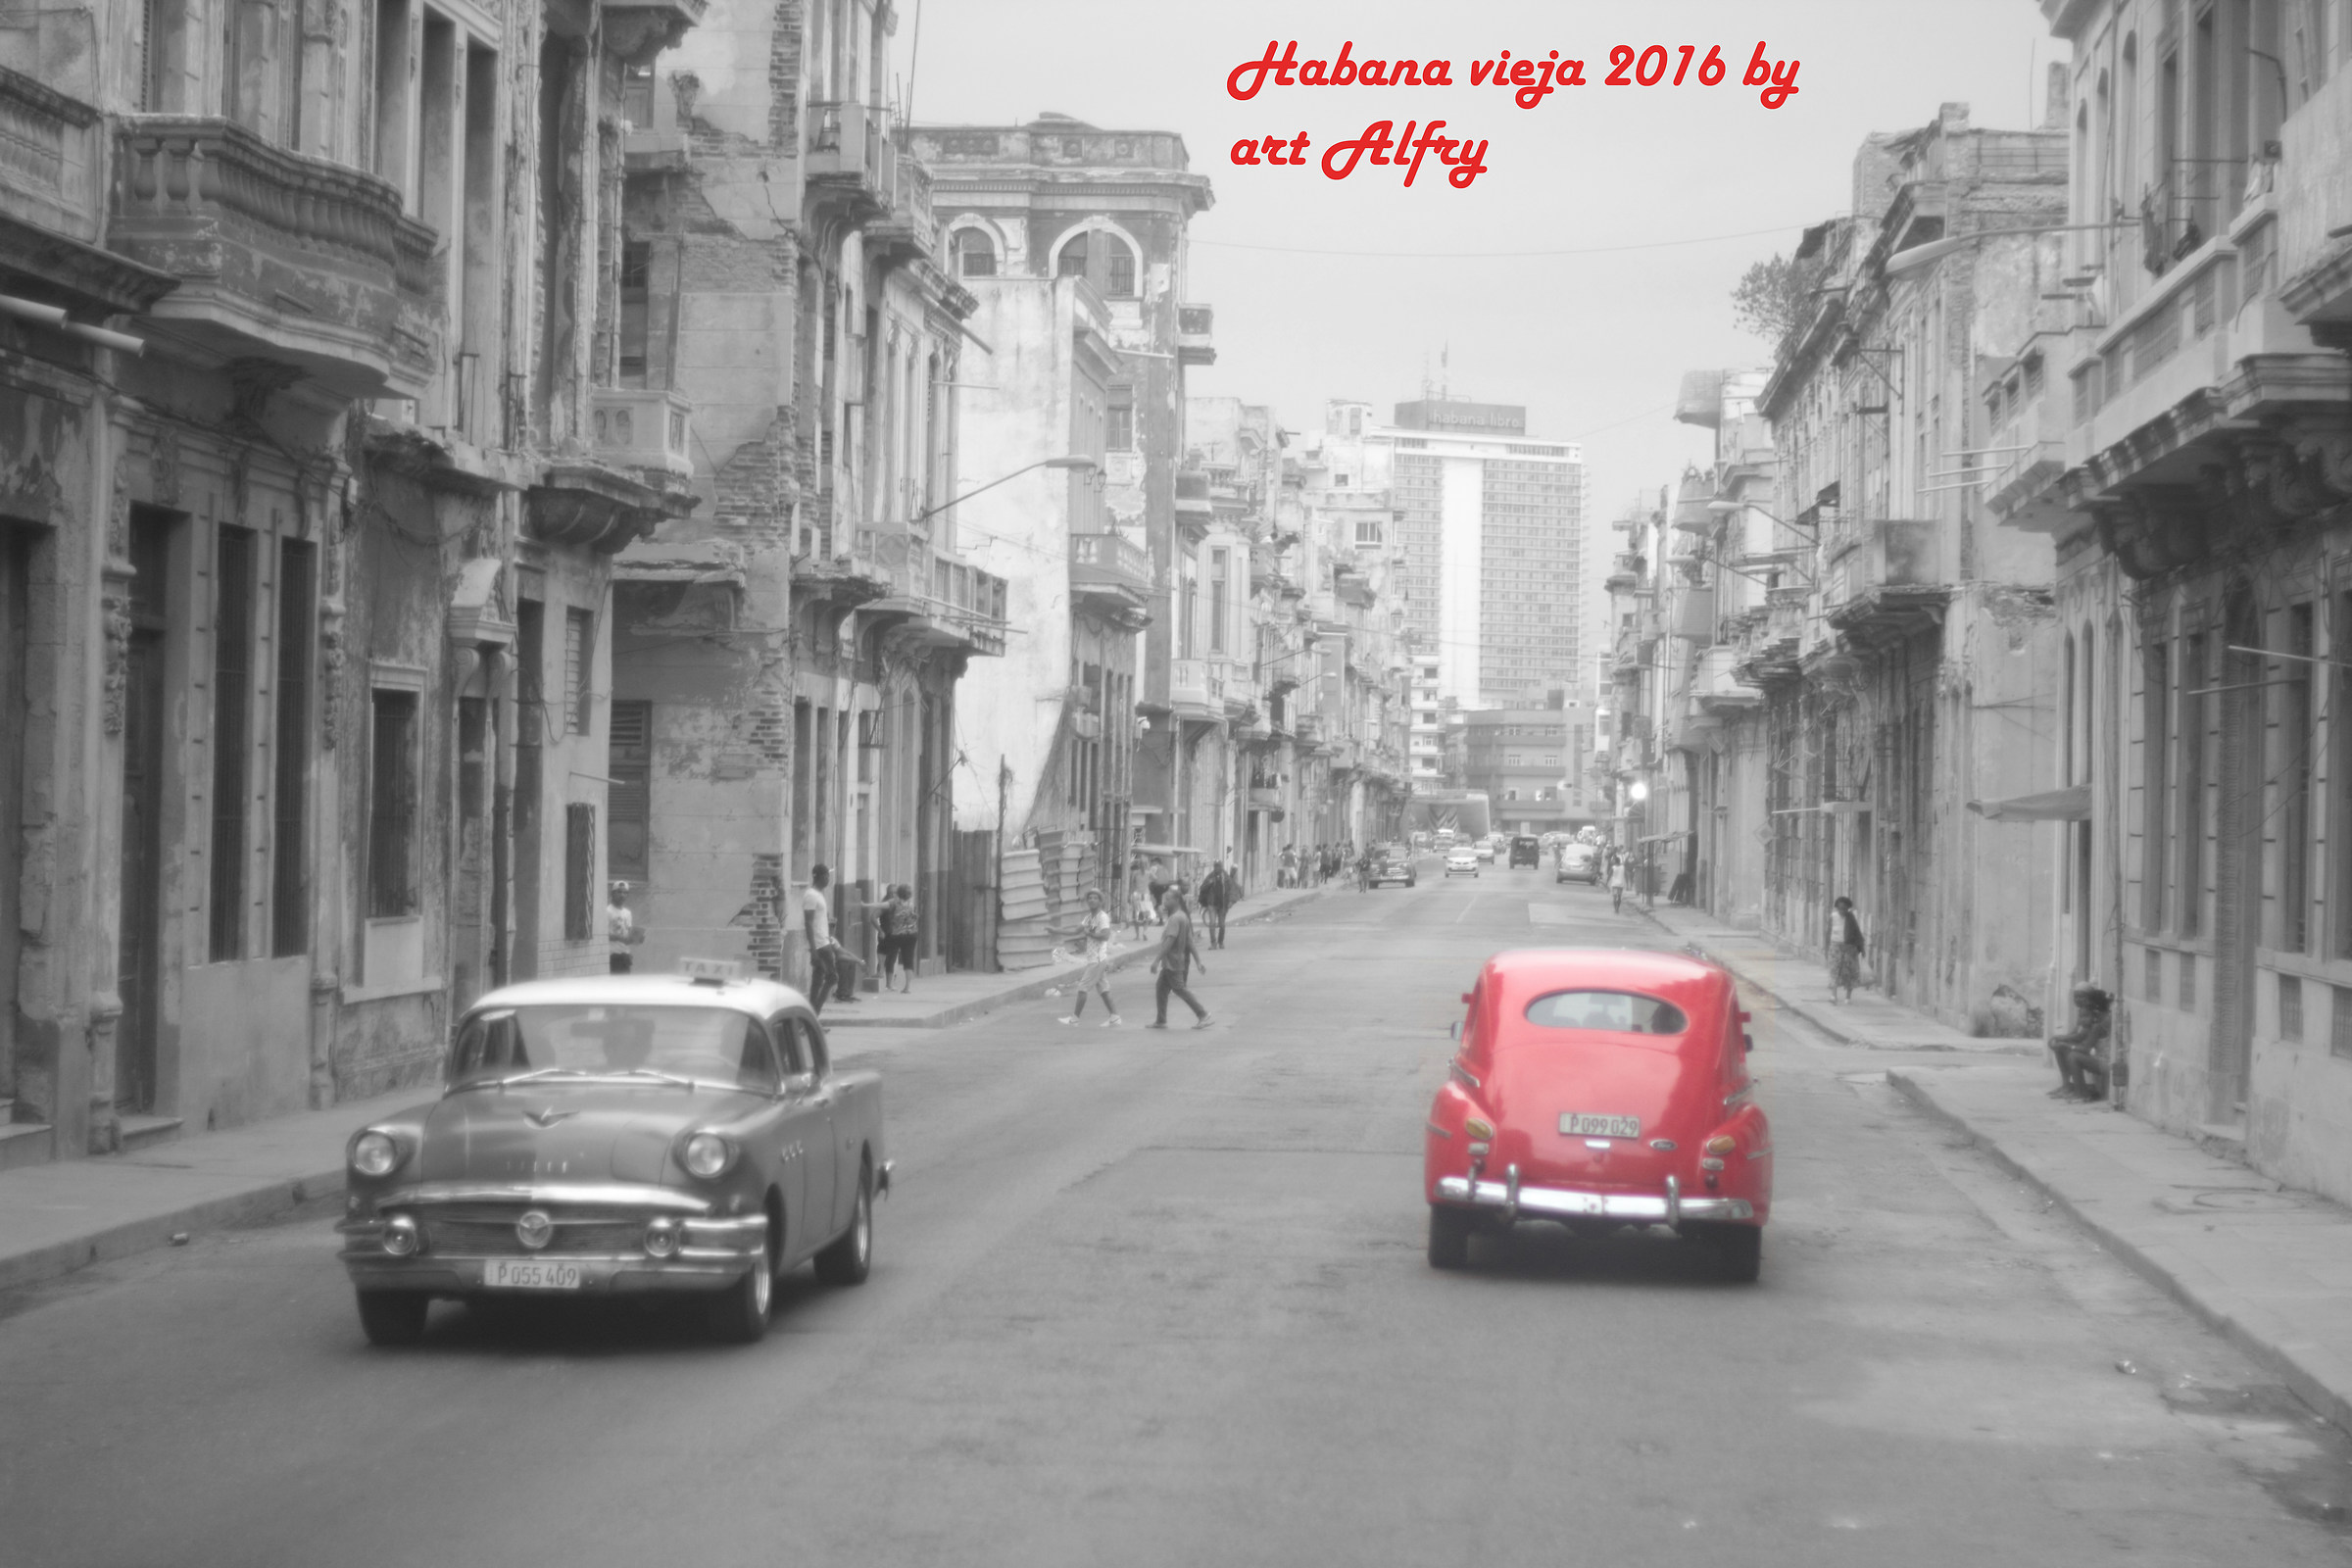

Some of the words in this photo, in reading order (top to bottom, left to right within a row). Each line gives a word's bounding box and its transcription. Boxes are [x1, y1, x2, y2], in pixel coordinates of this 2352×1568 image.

[1433, 409, 1485, 426] habana
[1582, 1117, 1608, 1134] 099
[1611, 1119, 1638, 1136] 029
[511, 1266, 541, 1286] 055
[545, 1266, 576, 1287] 409
